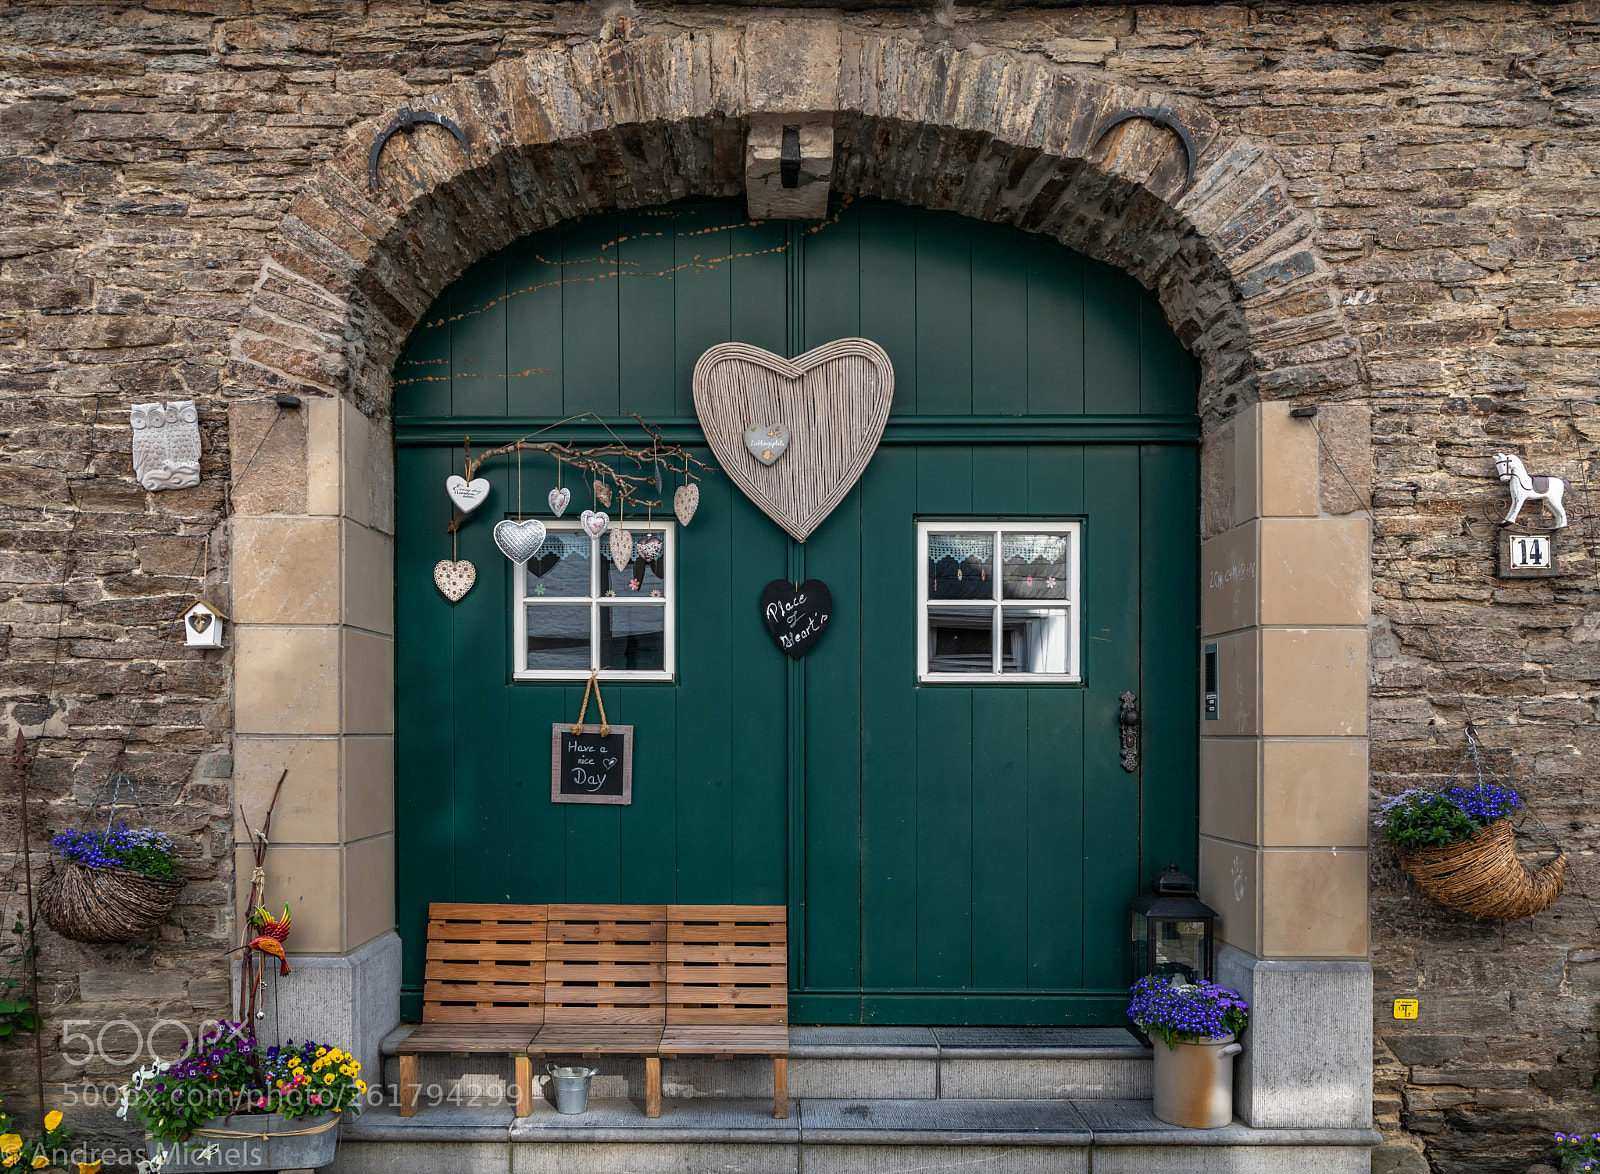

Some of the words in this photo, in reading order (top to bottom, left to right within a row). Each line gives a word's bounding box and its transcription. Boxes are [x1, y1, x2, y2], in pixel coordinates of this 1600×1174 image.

[1518, 539, 1542, 565] 14
[766, 594, 808, 623] Place
[787, 610, 806, 628] of
[568, 740, 595, 752] Have
[577, 754, 595, 765] nice
[571, 767, 607, 792] Day
